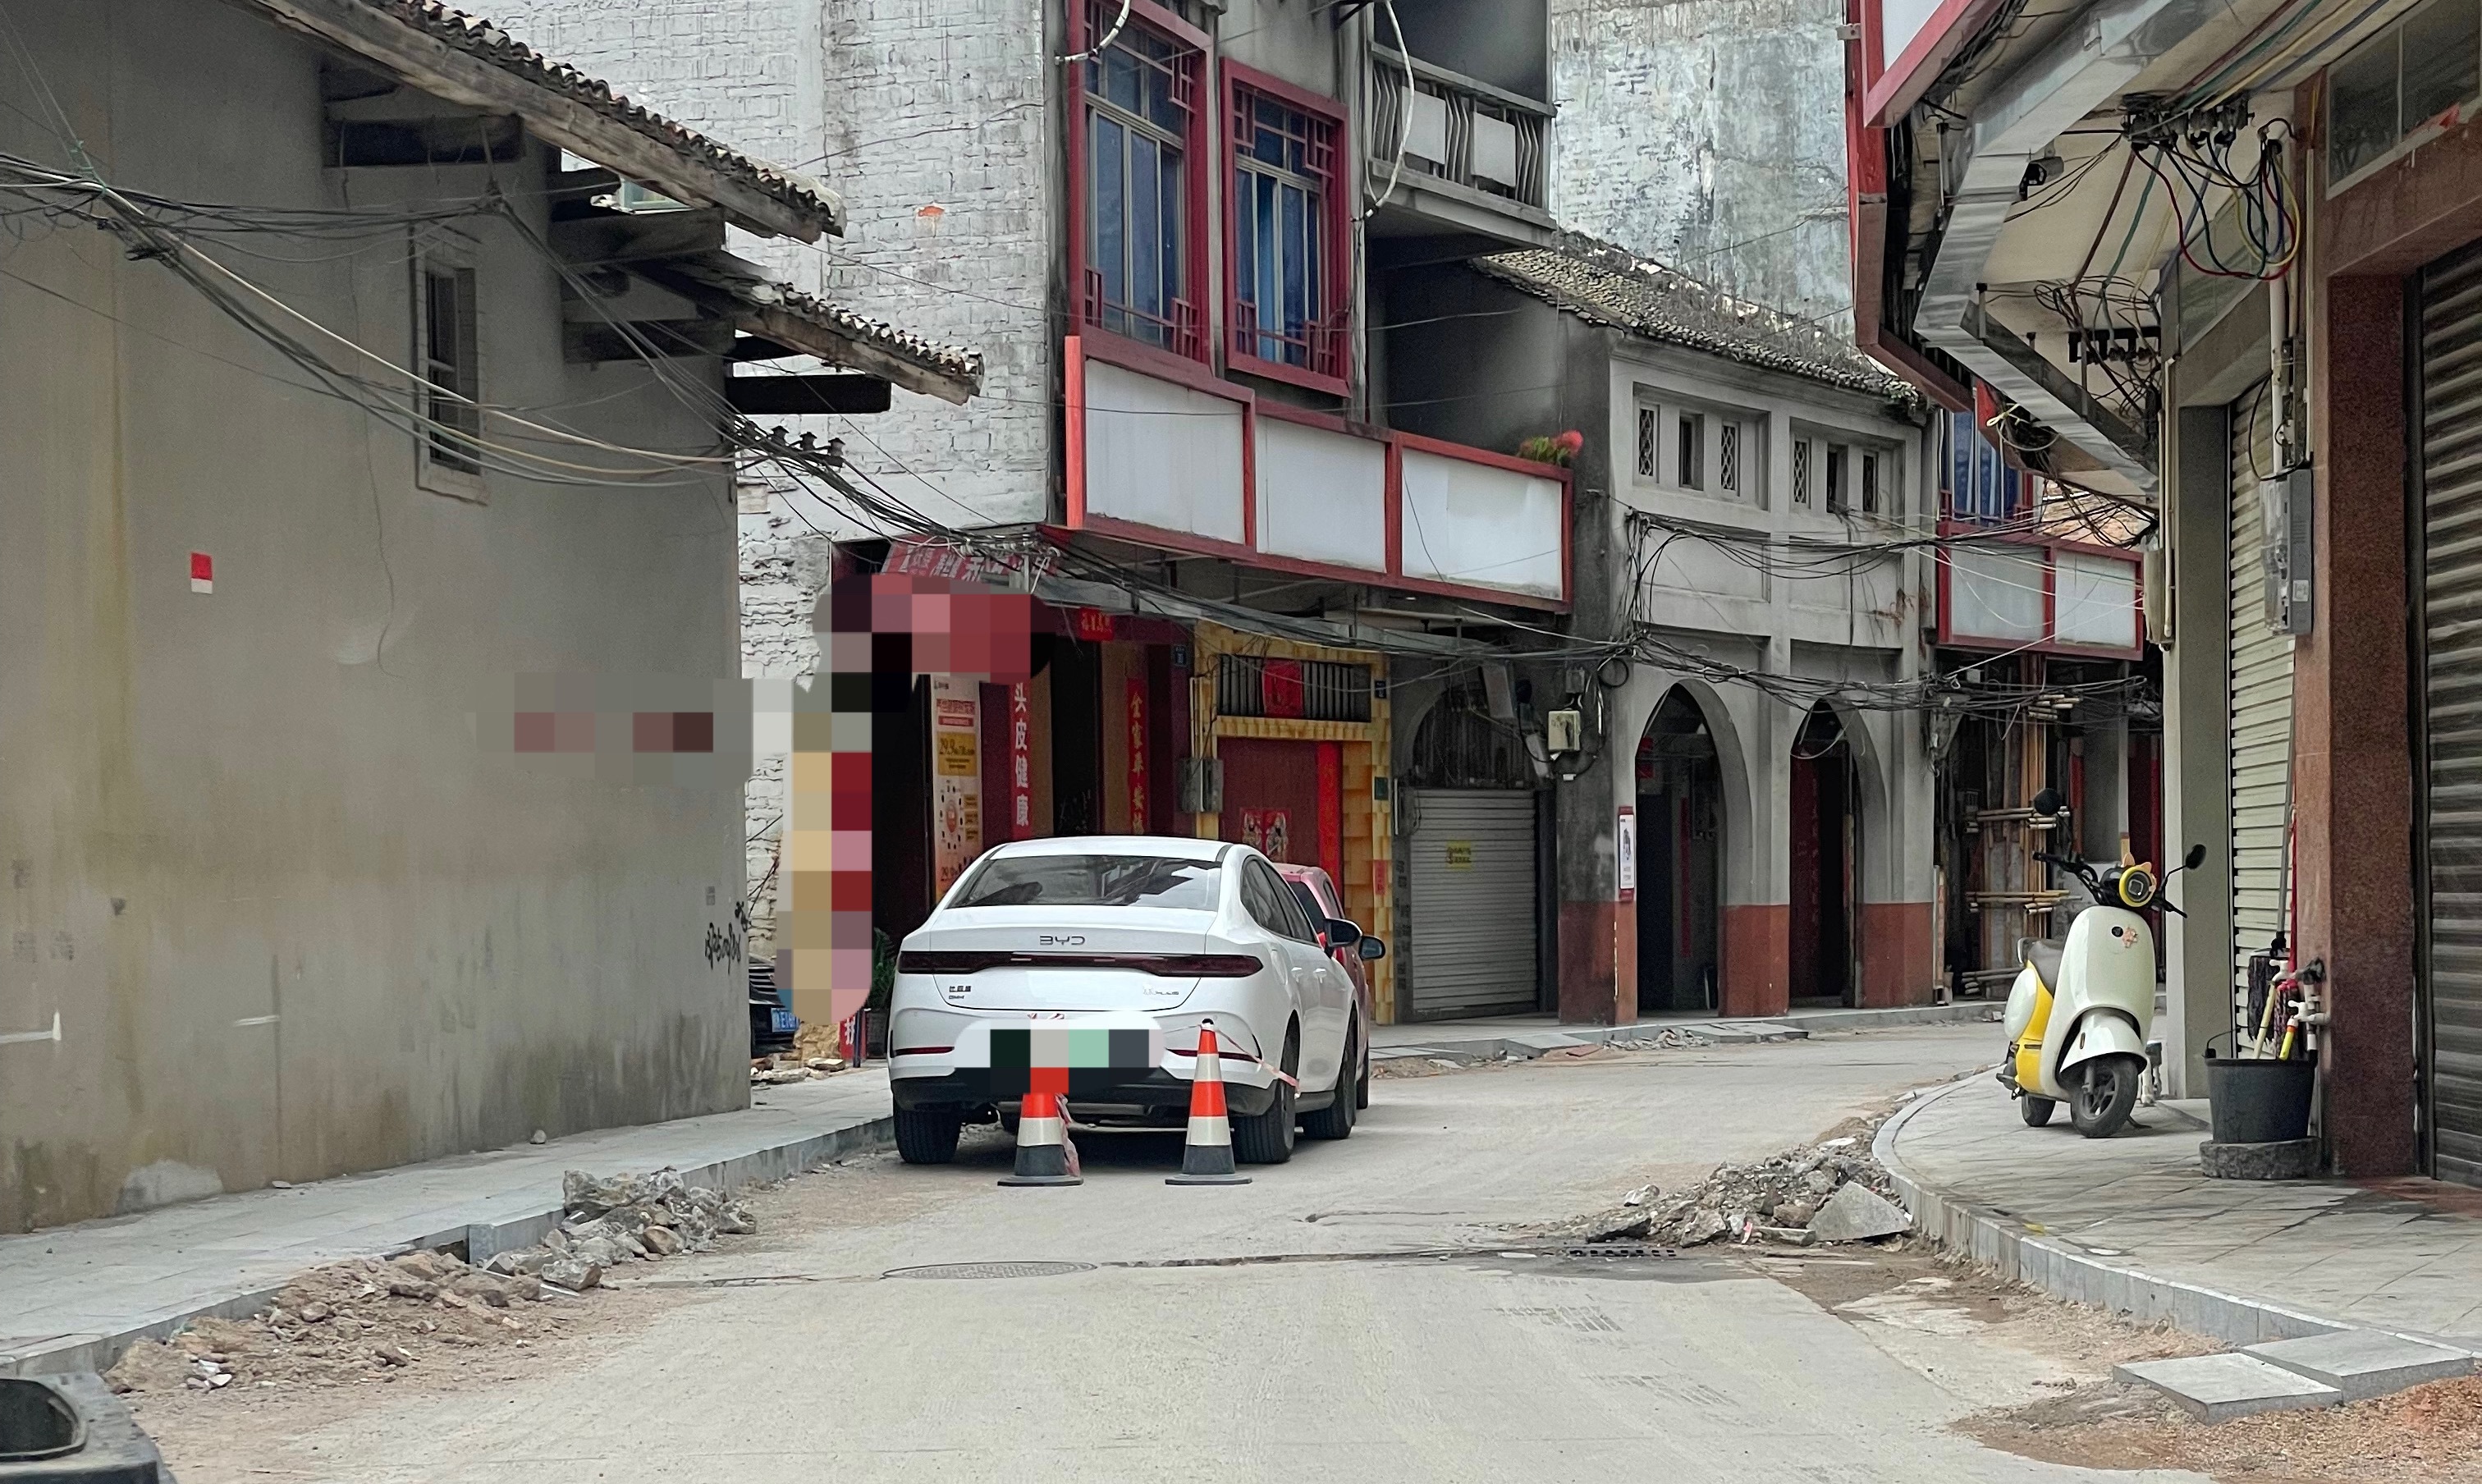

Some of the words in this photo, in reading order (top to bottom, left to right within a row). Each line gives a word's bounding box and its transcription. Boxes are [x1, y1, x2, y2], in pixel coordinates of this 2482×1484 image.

[1014, 682, 1028, 827] 头皮健康
[1040, 936, 1085, 946] BYD
